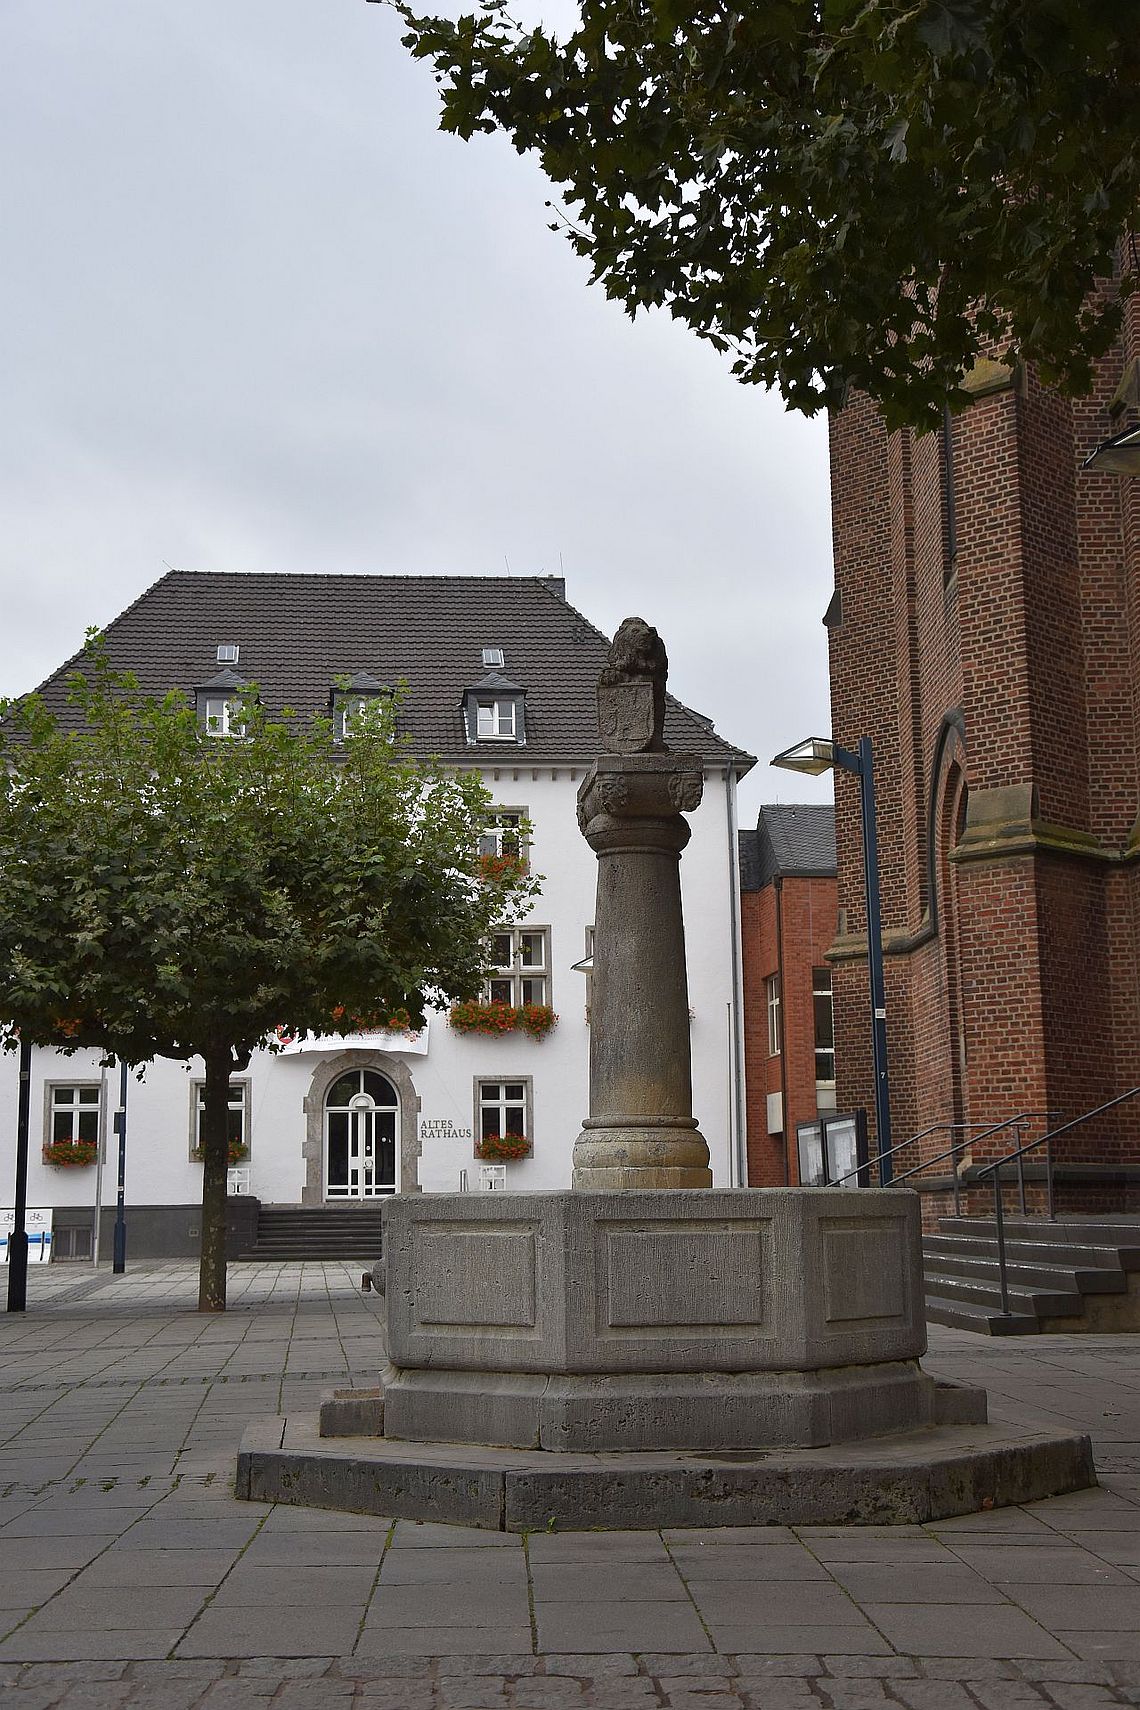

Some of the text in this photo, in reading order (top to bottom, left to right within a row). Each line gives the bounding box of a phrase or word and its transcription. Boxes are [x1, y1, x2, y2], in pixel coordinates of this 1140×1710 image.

[880, 1071, 886, 1079] 7
[421, 1120, 453, 1129] ALTES
[421, 1129, 472, 1138] RATHAUS
